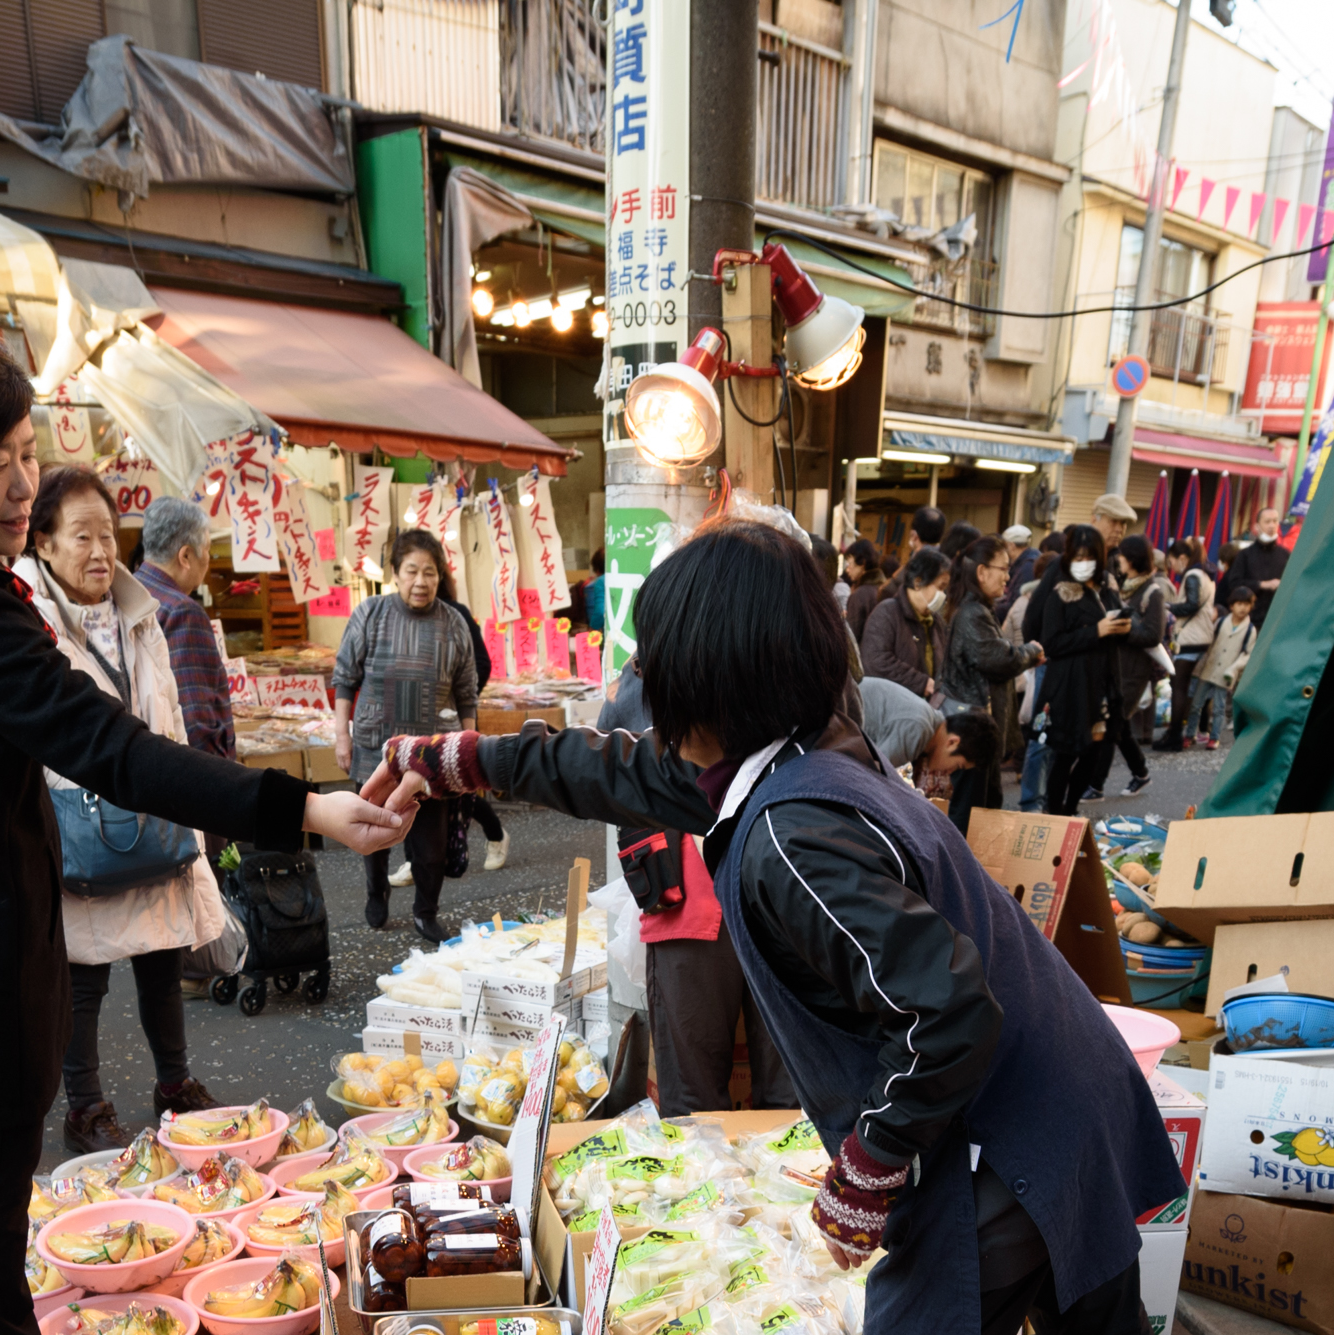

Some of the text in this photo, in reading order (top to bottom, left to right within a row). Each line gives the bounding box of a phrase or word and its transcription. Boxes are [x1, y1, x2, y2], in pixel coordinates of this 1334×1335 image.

[502, 984, 547, 1001] べったら漬
[408, 1016, 455, 1032] べったら漬
[421, 1040, 455, 1055] ったら漬
[1198, 1240, 1265, 1266] MARKETED BY
[1182, 1257, 1308, 1320] unkist
